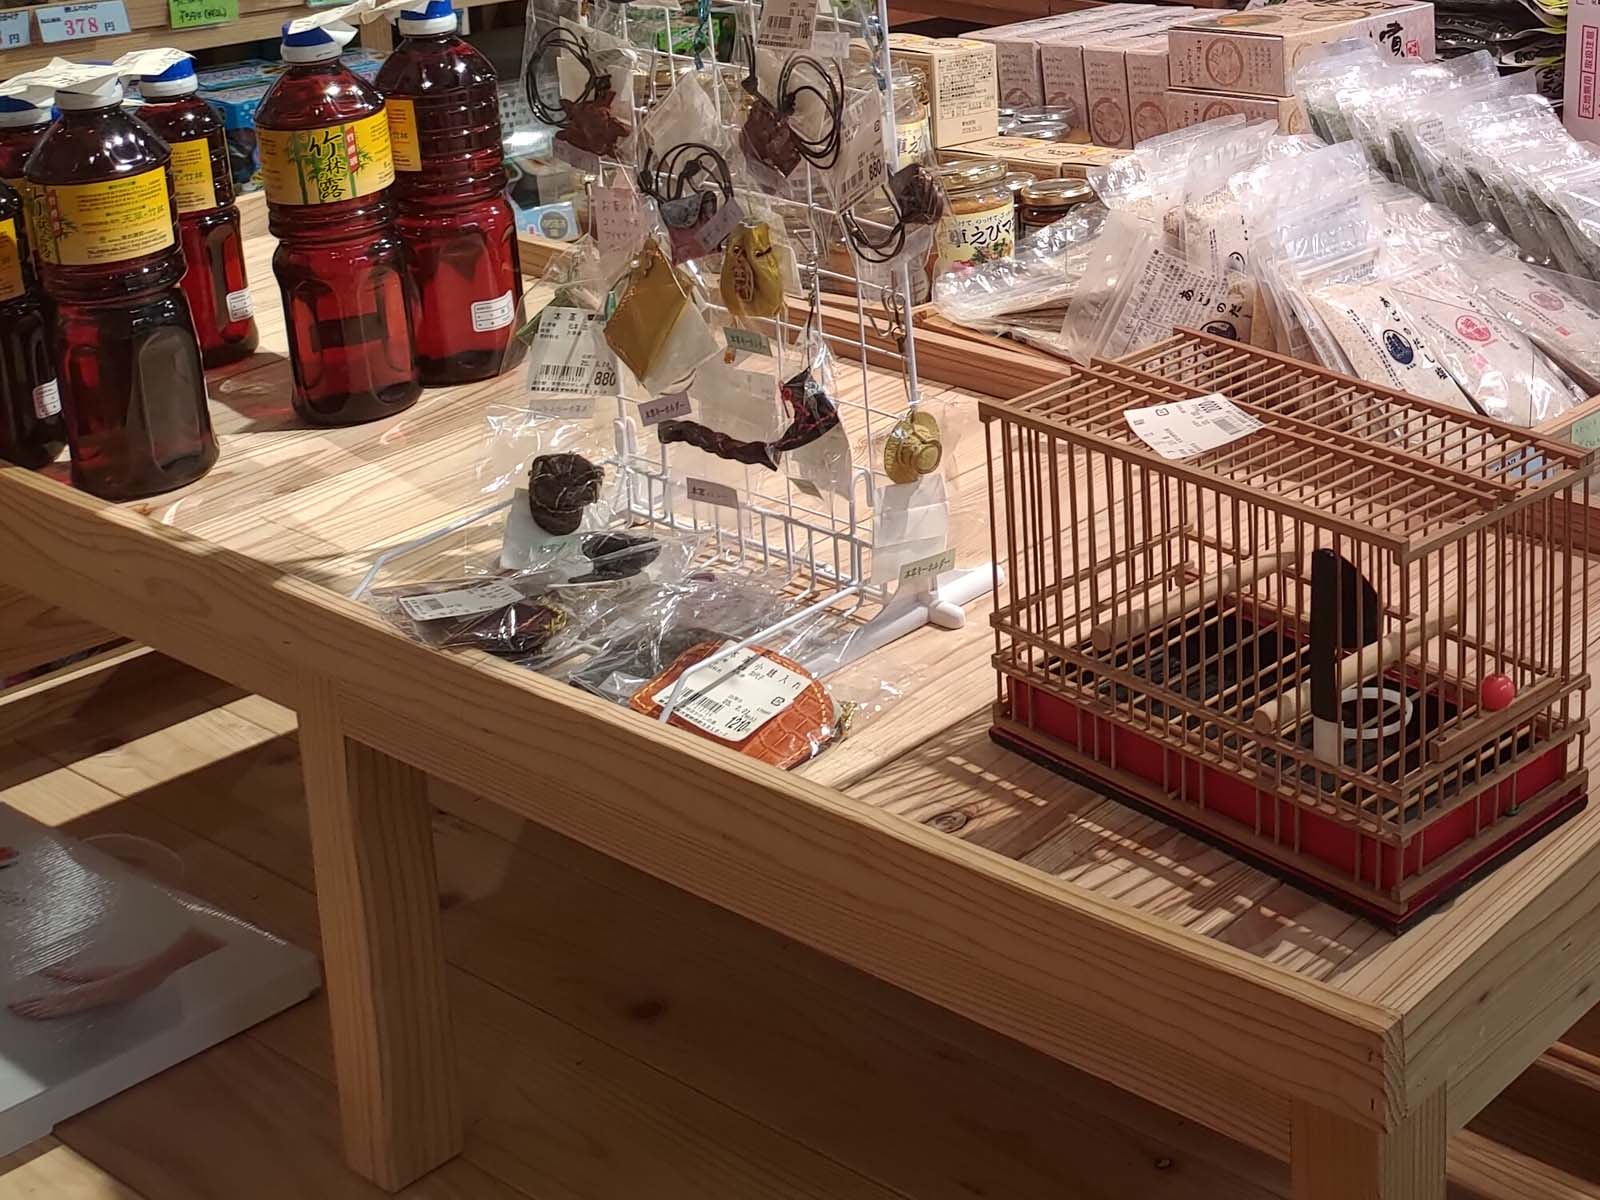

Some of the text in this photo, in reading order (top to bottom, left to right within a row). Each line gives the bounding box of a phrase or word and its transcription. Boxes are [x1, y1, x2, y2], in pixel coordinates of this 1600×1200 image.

[65, 17, 116, 36] 378 円
[594, 371, 616, 387] 880
[725, 716, 751, 733] 1210
